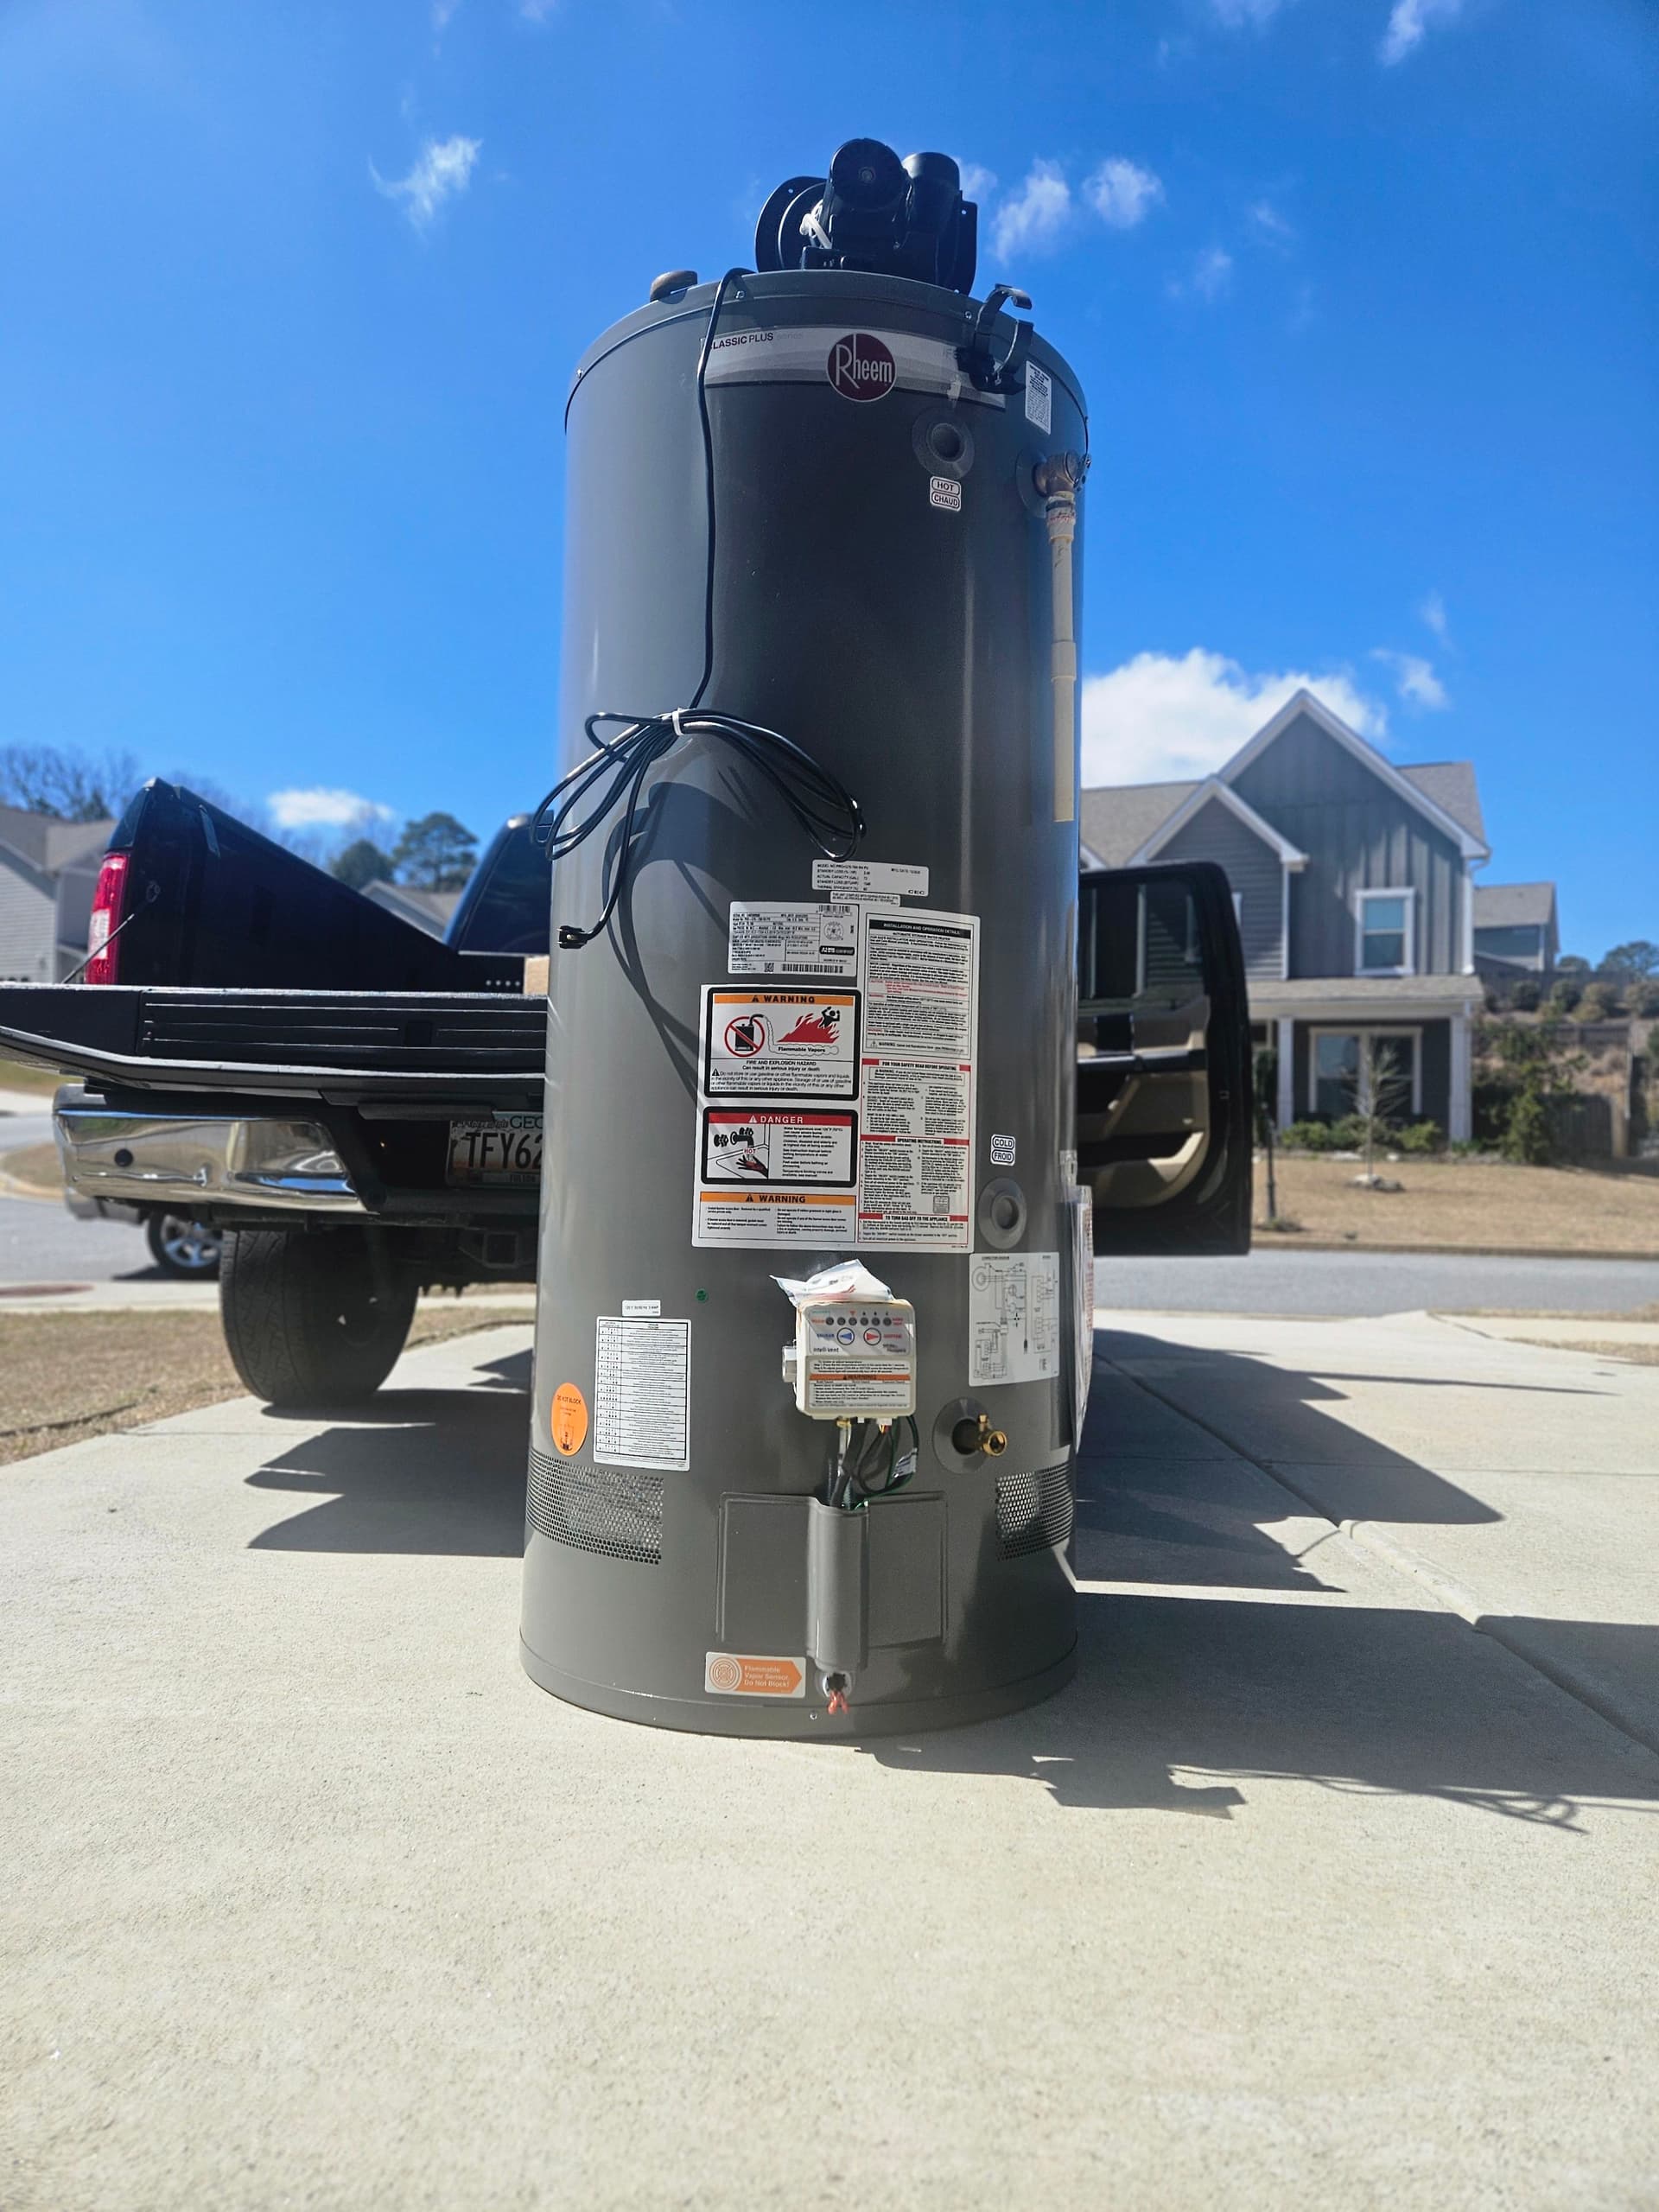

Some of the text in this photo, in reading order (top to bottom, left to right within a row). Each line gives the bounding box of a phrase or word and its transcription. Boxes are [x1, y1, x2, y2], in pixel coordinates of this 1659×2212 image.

[710, 335, 747, 349] LASSIC
[748, 332, 774, 343] PLUS
[836, 334, 893, 390] Rheem
[937, 481, 955, 492] HOT
[934, 493, 958, 506] CHAUD
[760, 1116, 804, 1124] DANGER
[994, 1138, 1013, 1148] COLD
[994, 1151, 1012, 1161] FROID
[759, 1195, 806, 1204] WARNING
